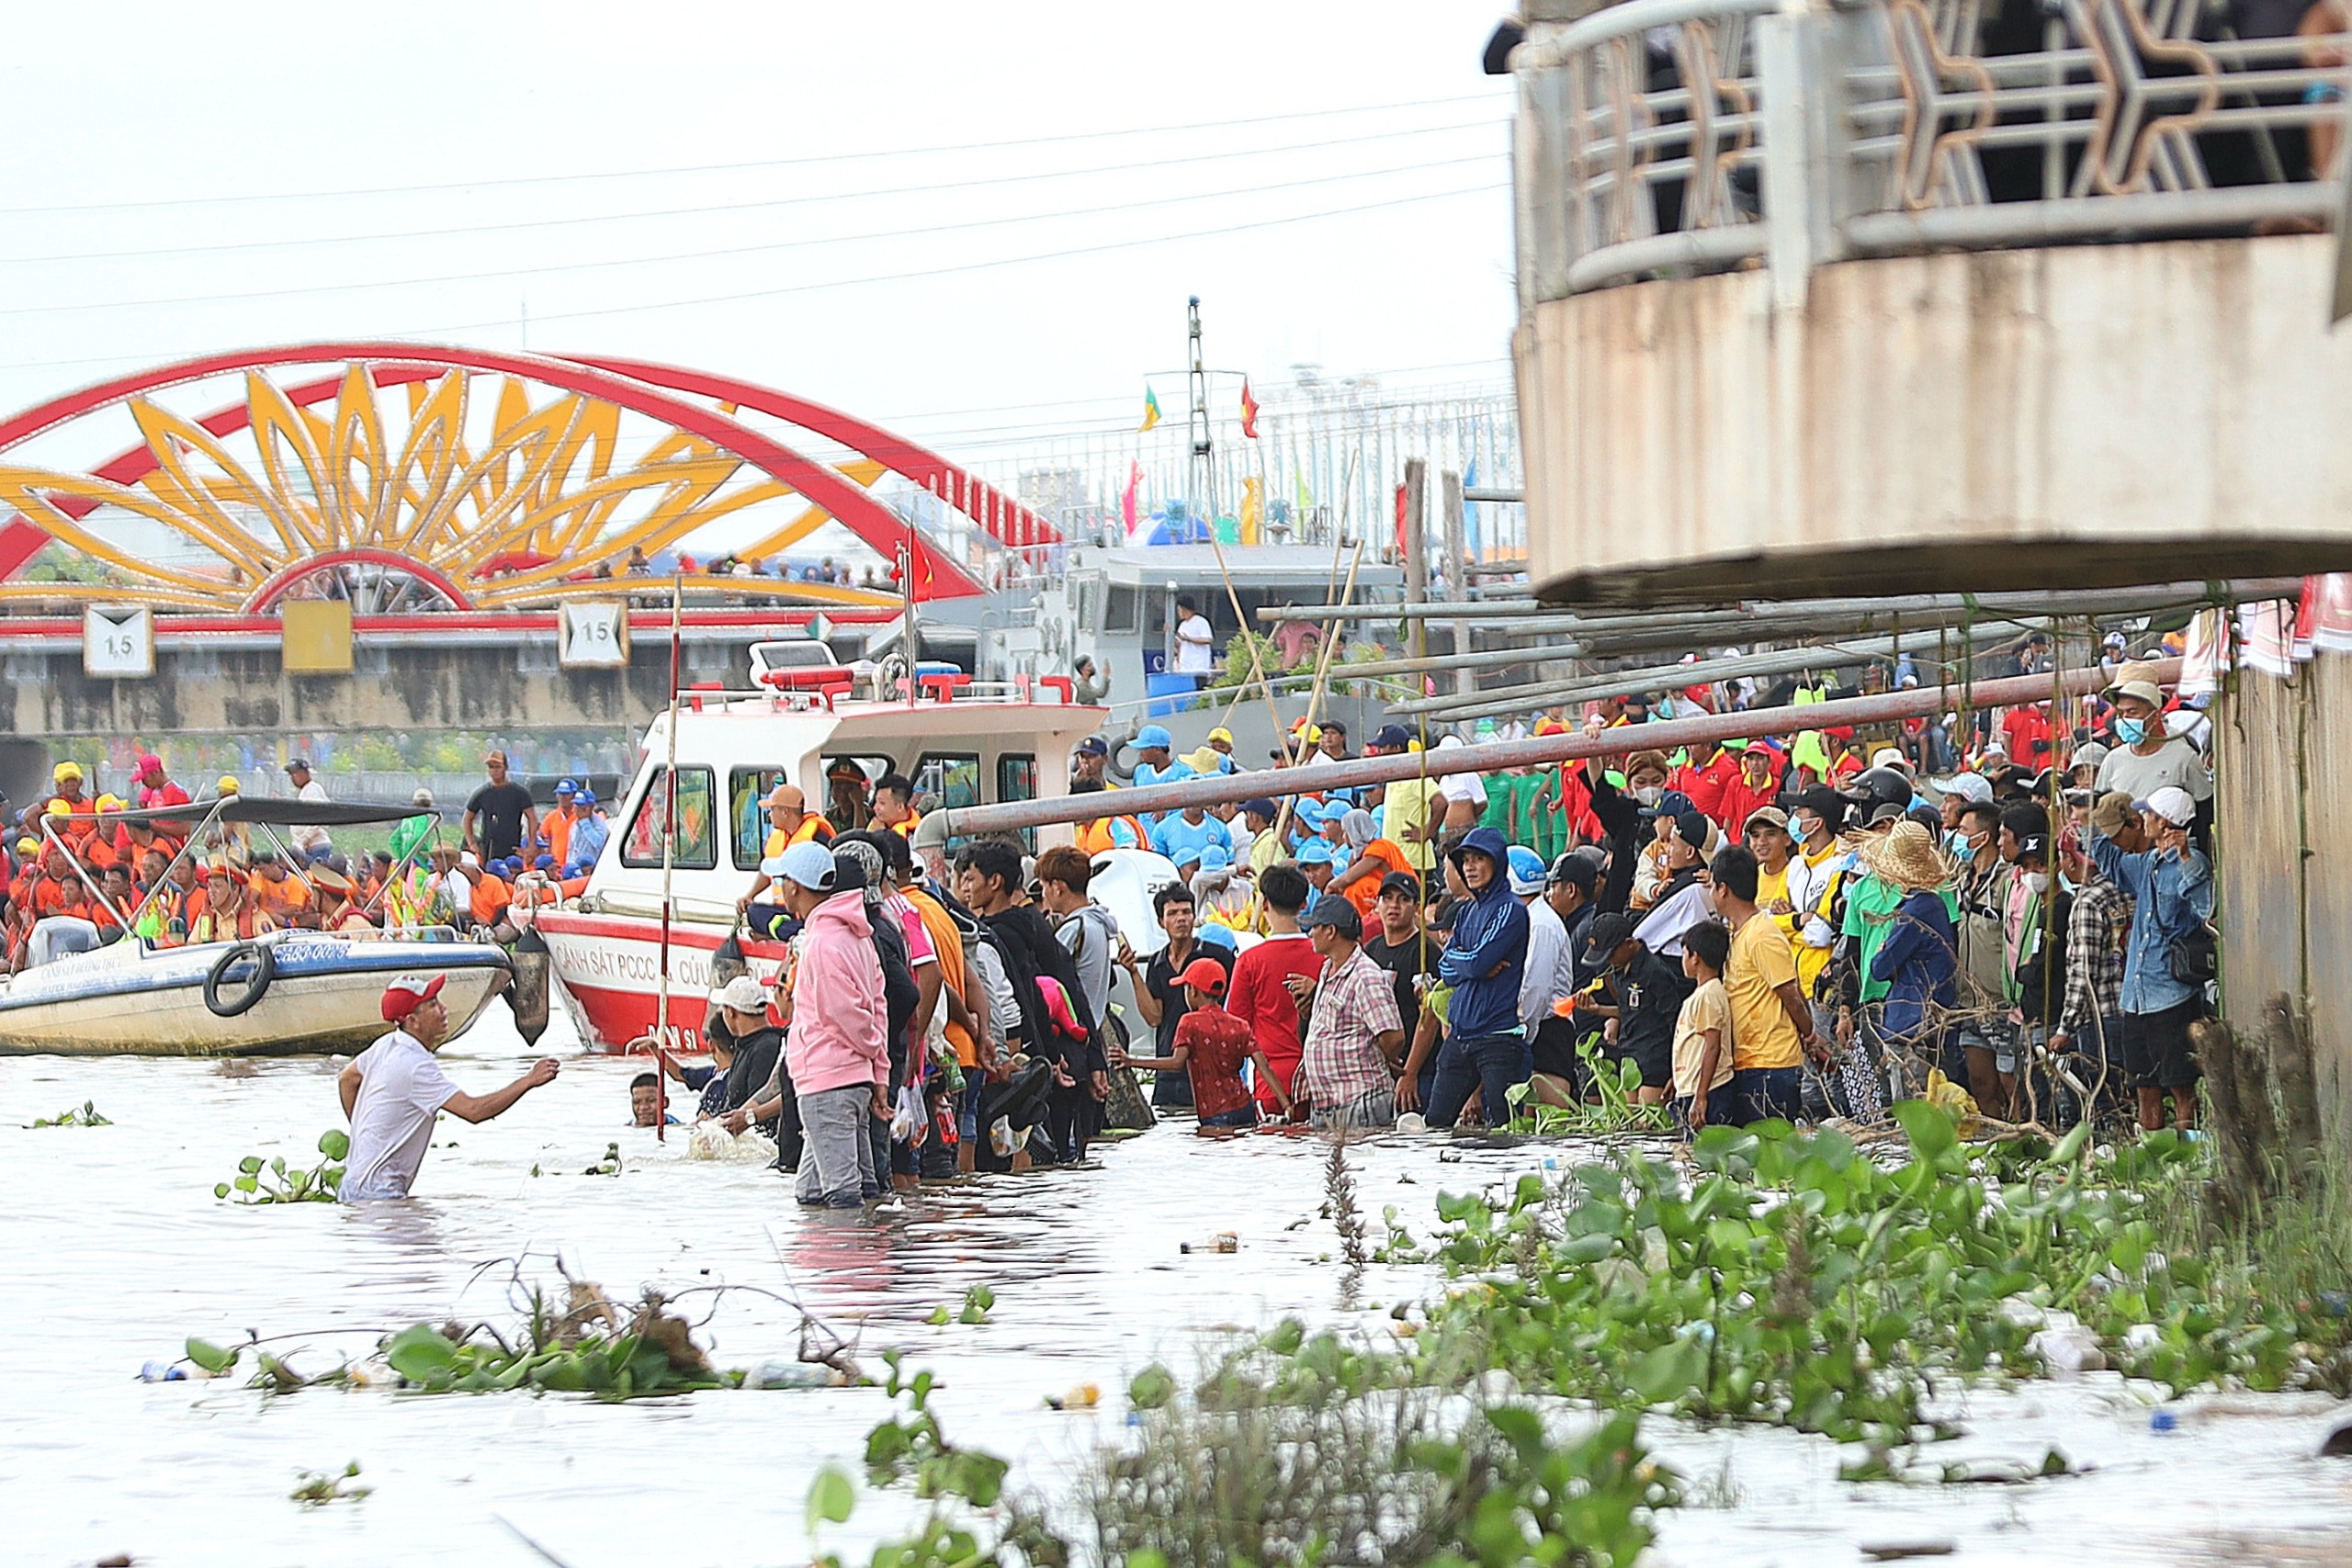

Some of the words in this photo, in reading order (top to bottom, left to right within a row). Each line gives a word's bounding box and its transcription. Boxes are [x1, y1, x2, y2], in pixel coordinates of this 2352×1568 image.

[582, 621, 607, 642] 15
[590, 946, 615, 976] SÁT
[617, 953, 656, 981] PCCC
